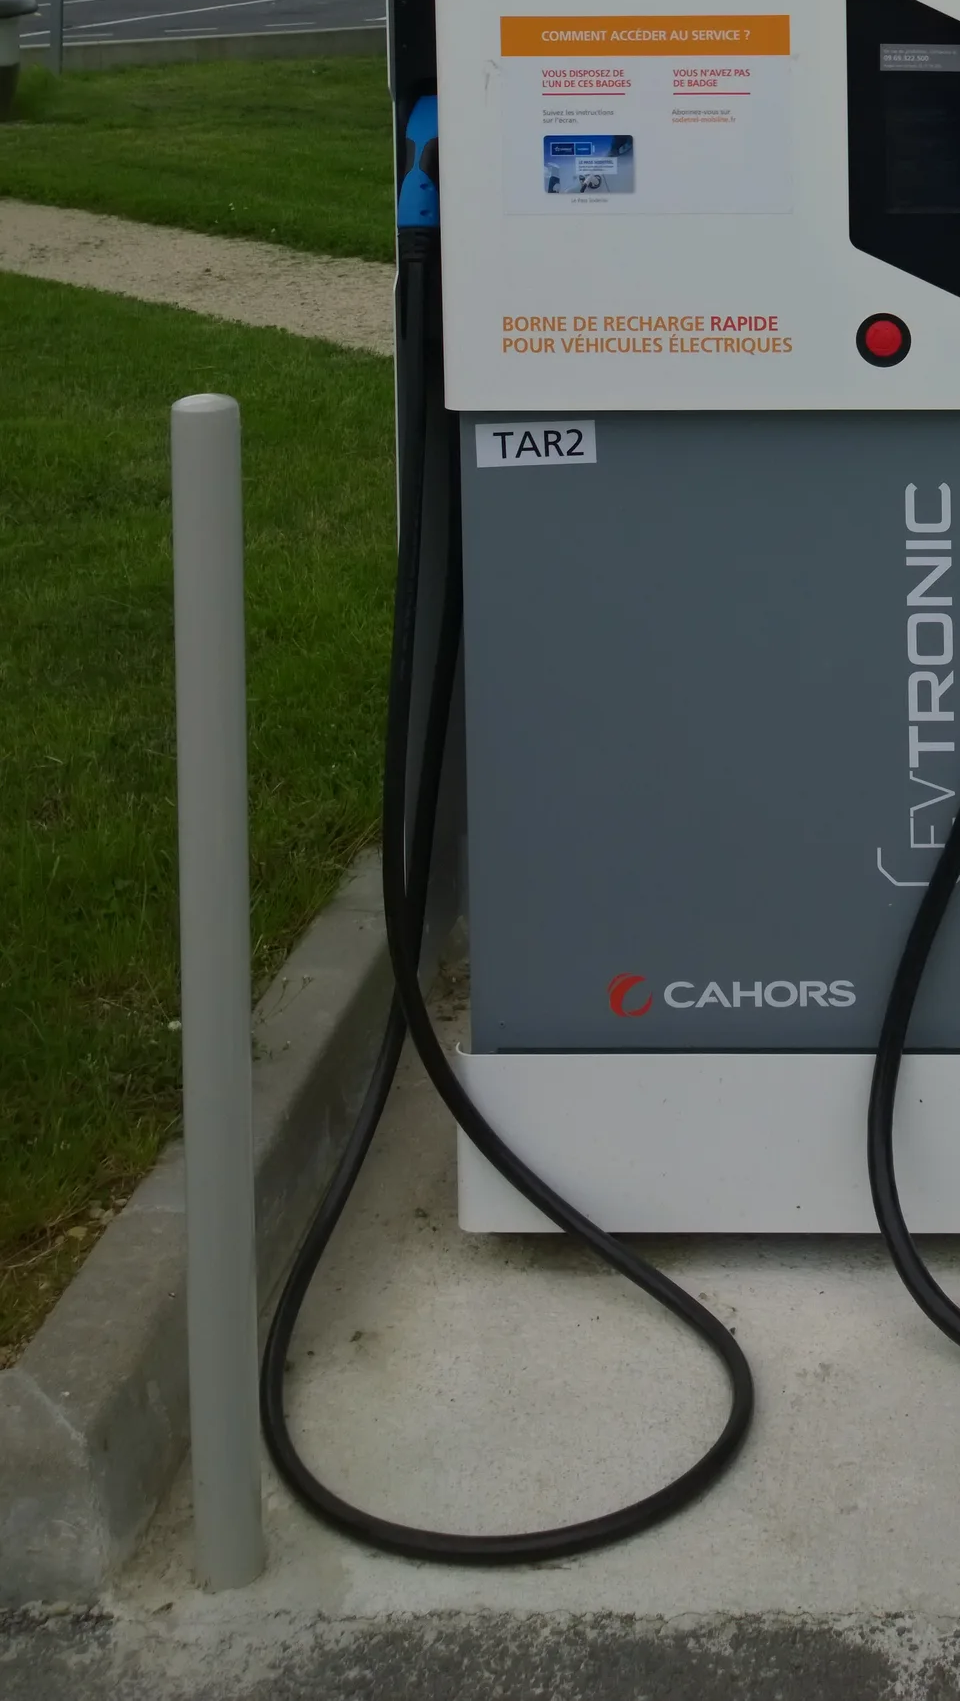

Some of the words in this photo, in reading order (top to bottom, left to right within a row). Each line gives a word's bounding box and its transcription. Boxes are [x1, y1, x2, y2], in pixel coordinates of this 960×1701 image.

[541, 31, 608, 41] COMMENT
[610, 28, 666, 41] ACCÉDER
[669, 30, 688, 41] AU
[692, 30, 740, 40] SERVICE
[744, 30, 750, 40] ?
[542, 70, 567, 78] VOUS
[569, 69, 610, 77] DISPOSEZ
[613, 69, 624, 77] DE
[673, 69, 698, 77] VOUS
[700, 69, 732, 77] N'AVEZ
[734, 69, 750, 77] PAS
[542, 80, 561, 88] L'UN
[596, 79, 631, 87] BADGES
[687, 79, 718, 87] BADGE
[502, 316, 567, 332] BORNE
[573, 316, 598, 332] DE
[603, 315, 705, 332] RECHARGE
[710, 316, 778, 331] RAPIDE
[502, 337, 556, 353] POUR
[561, 334, 663, 353] VÉHICULES
[669, 334, 793, 355] ÉLECTRIQUES
[493, 429, 585, 459] TAR2
[663, 980, 857, 1008] CAHORS
